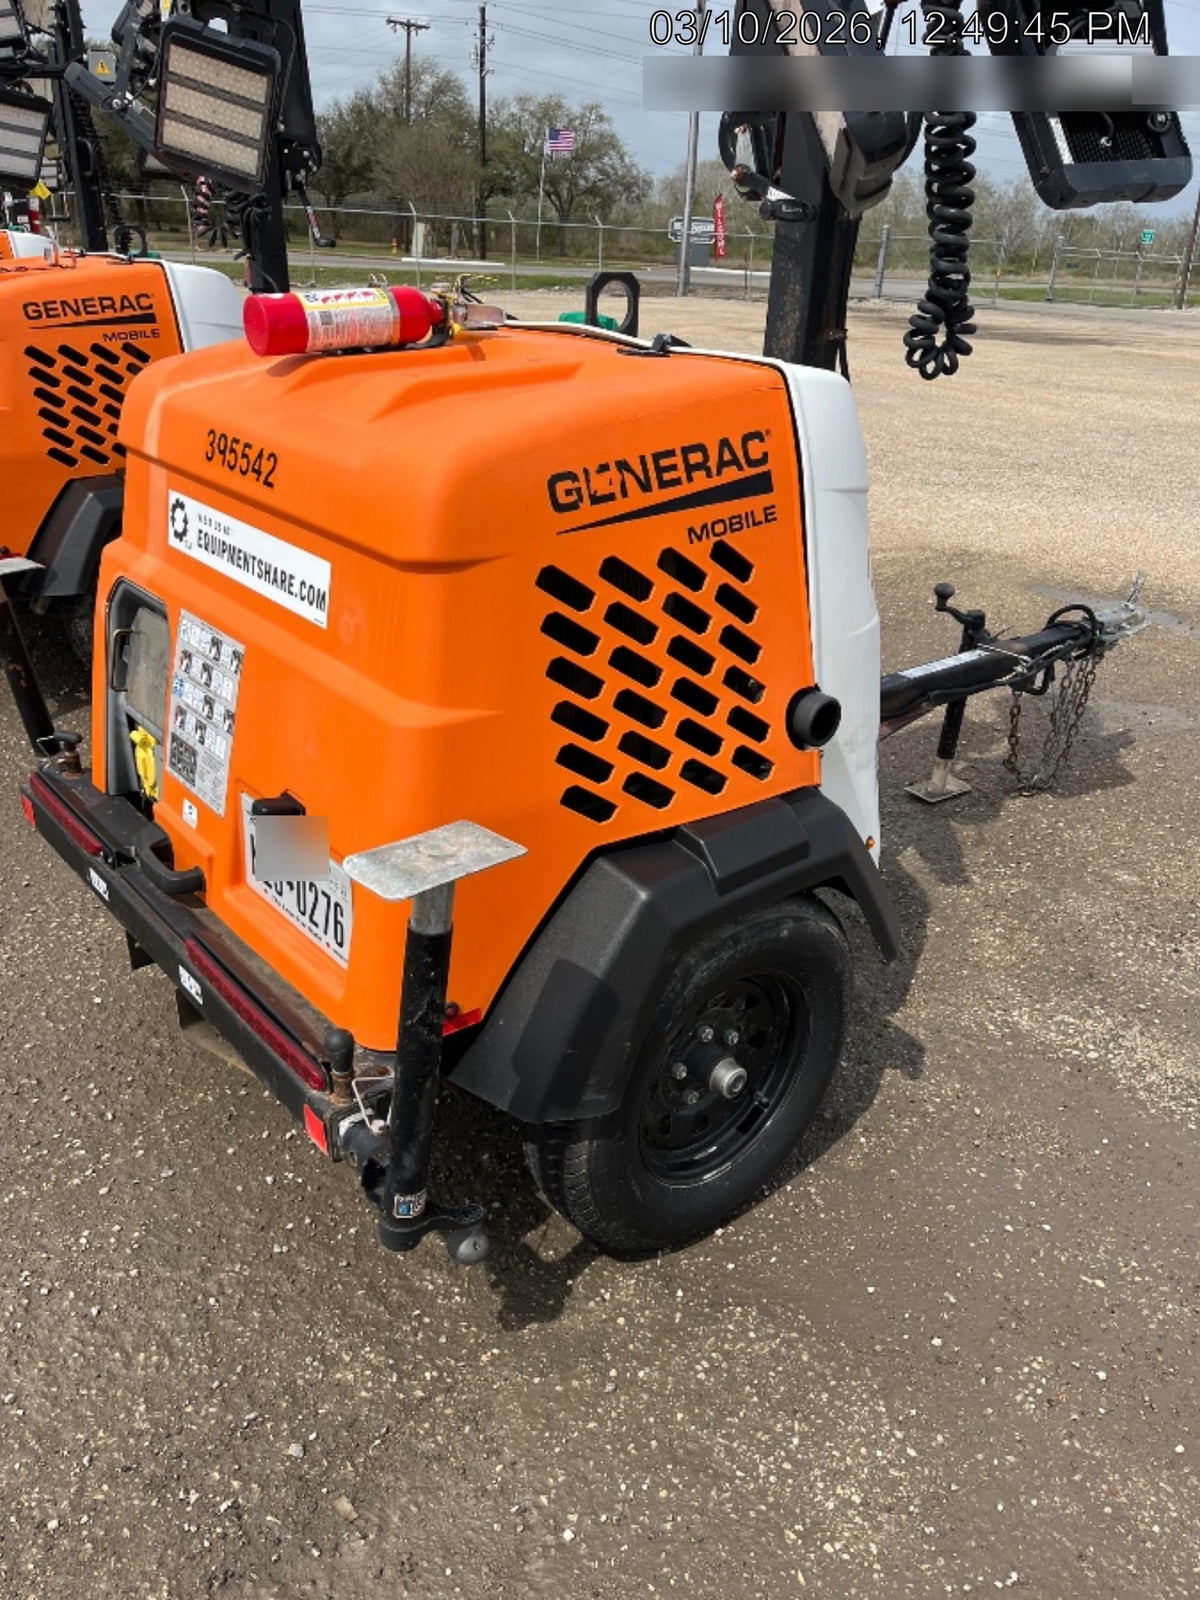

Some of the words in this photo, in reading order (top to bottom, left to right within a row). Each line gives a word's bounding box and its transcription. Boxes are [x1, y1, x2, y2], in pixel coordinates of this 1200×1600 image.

[23, 292, 153, 321] GENERAC
[102, 328, 160, 342] MOBILE
[205, 428, 279, 489] 395542
[687, 504, 778, 545] MOBILE
[197, 528, 327, 613] EQUIPMENTSHARE.COM
